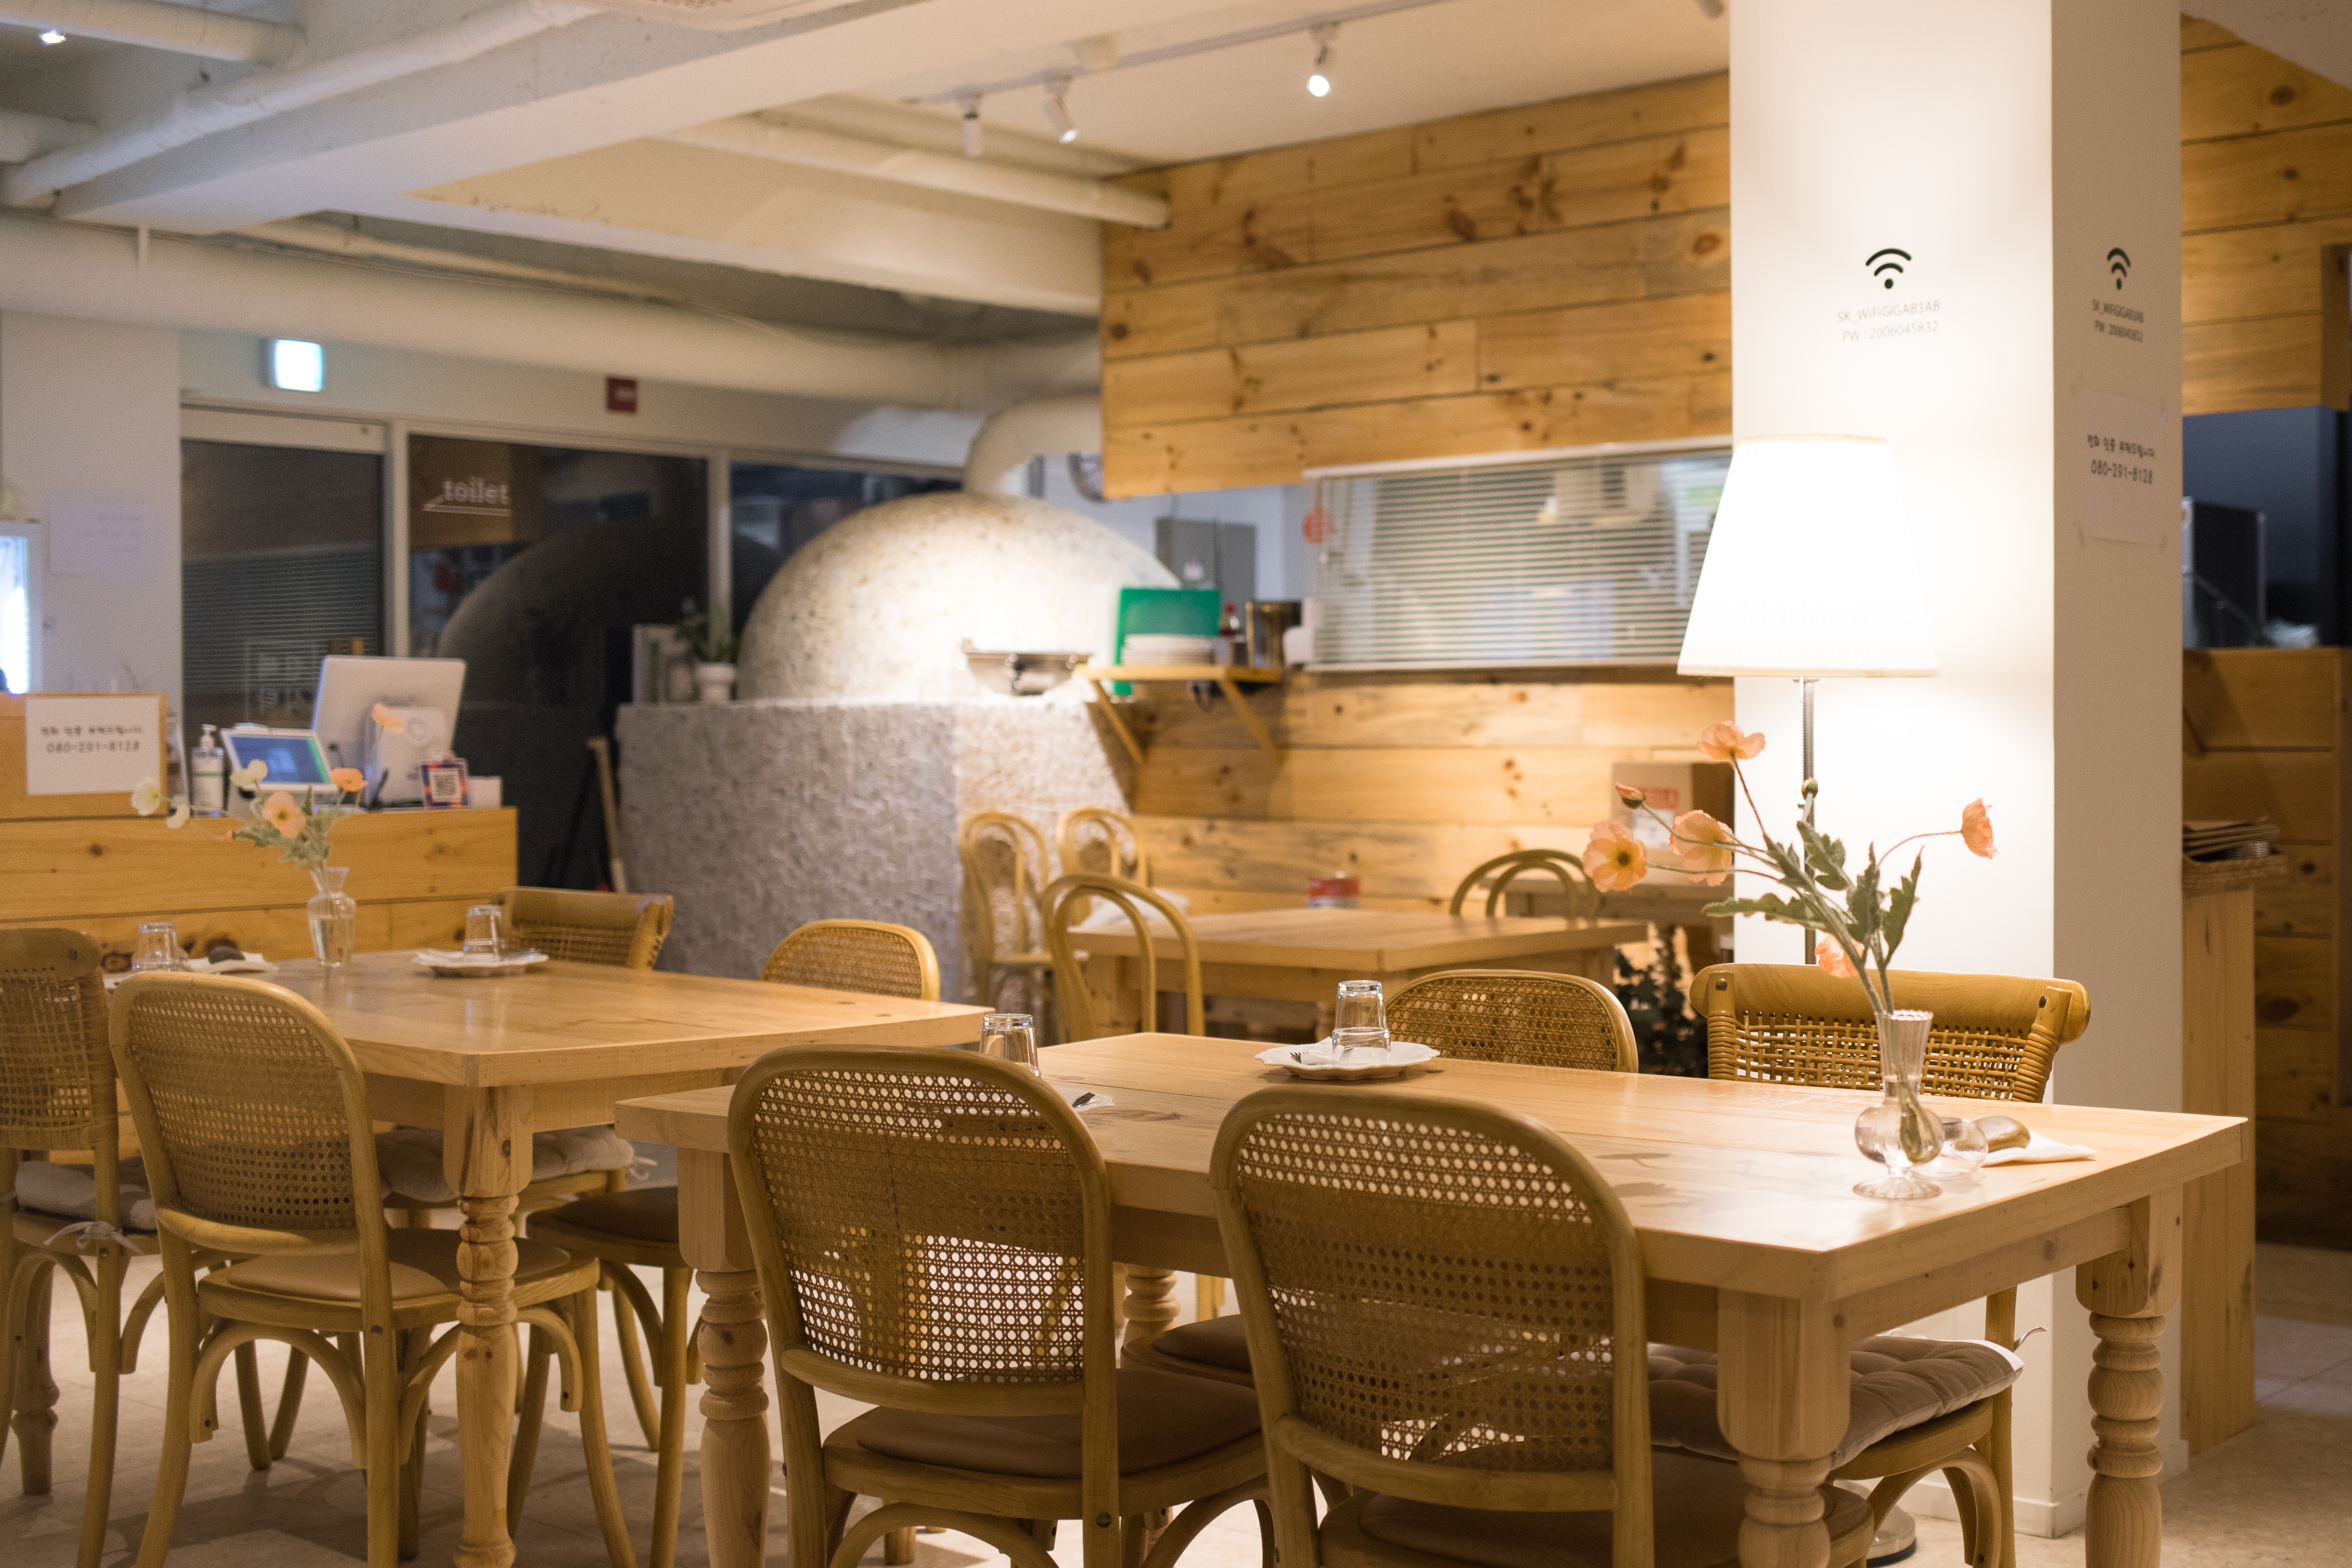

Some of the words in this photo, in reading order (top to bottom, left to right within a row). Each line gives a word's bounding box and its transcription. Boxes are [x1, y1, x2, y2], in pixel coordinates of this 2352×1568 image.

[1843, 329, 1861, 342] PW
[2091, 459, 2153, 484] 080-291-8128
[443, 476, 509, 506] toilet
[47, 740, 140, 754] 080-291-8128
